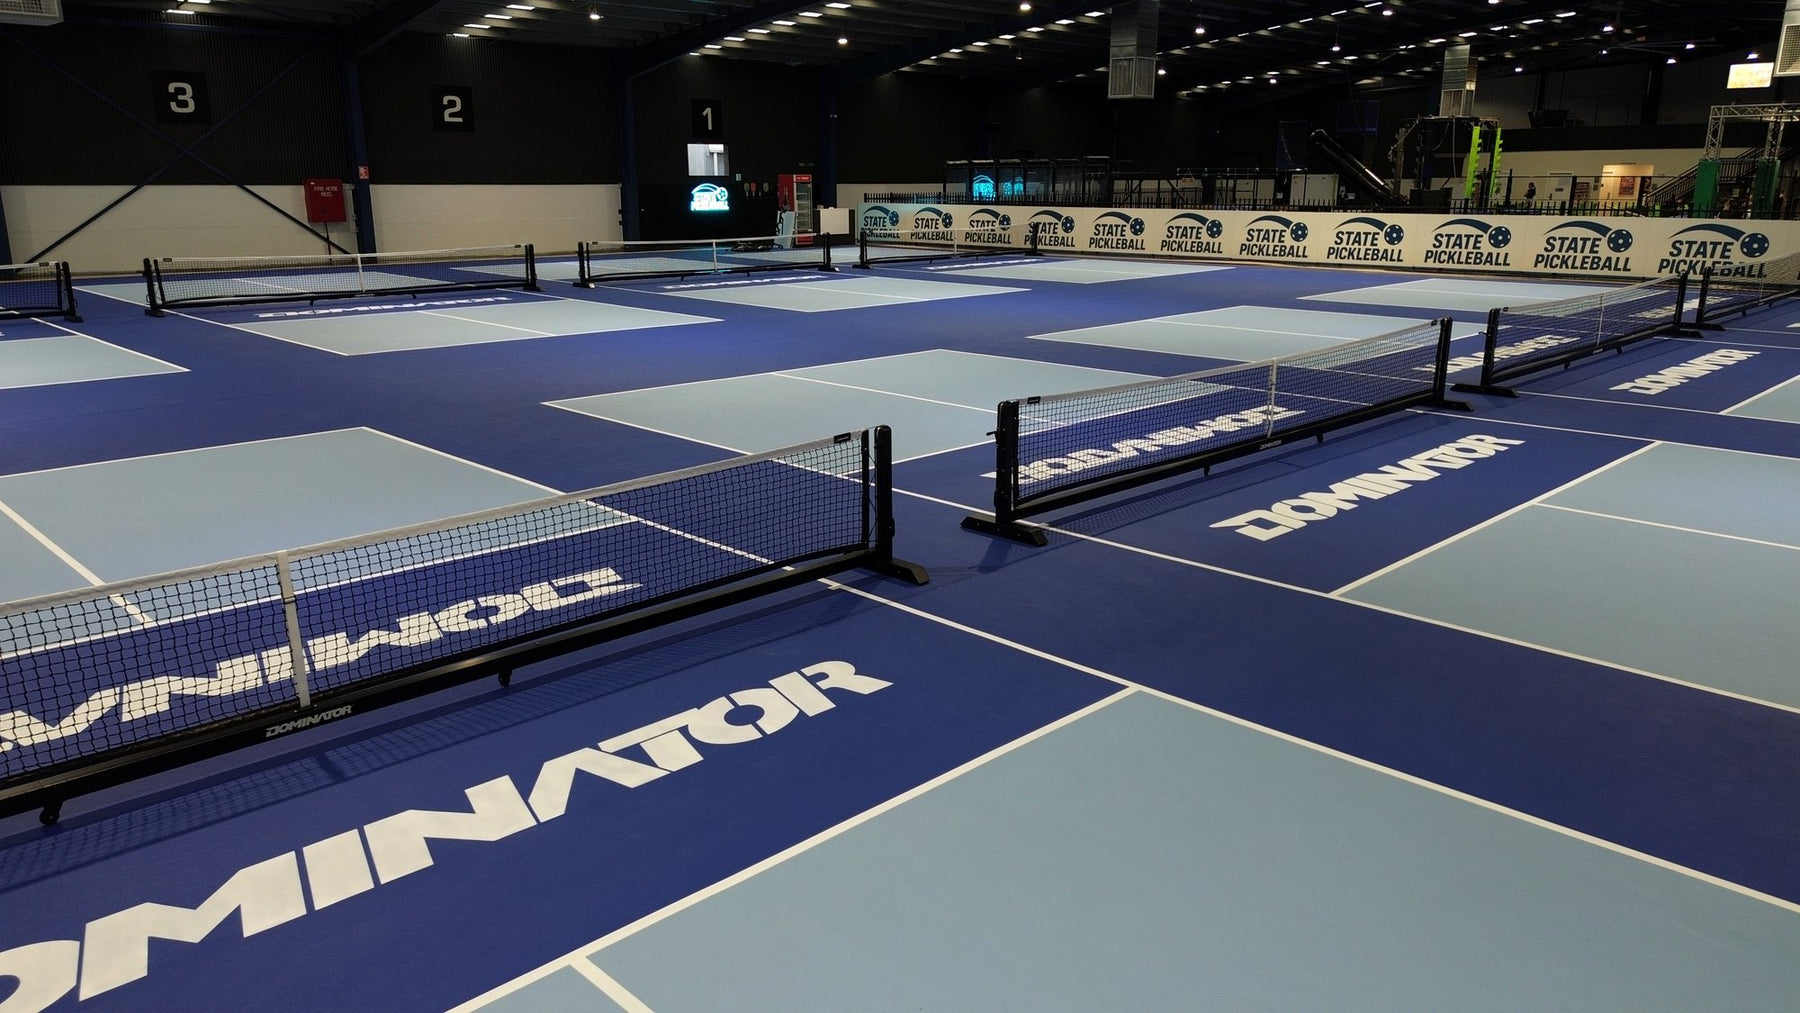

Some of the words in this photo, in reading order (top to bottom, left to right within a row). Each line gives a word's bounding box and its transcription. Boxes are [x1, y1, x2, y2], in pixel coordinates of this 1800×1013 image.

[168, 82, 195, 113] 3
[442, 95, 463, 122] 2
[702, 107, 712, 130] 1
[864, 216, 887, 227] STATE
[914, 217, 939, 229] STATE
[969, 219, 997, 232] STATE
[910, 231, 954, 241] PICKLEBALL
[1094, 223, 1127, 237] STATE
[1166, 225, 1203, 240] STATE
[1246, 228, 1286, 243] STATE
[964, 232, 1012, 244] PICKLEBALL
[1089, 237, 1145, 250] PICKLEBALL
[1334, 231, 1380, 246] STATE
[1432, 233, 1483, 250] STATE
[1543, 236, 1602, 254] STATE
[1160, 239, 1223, 254] PICKLEBALL
[1239, 244, 1308, 258] PICKLEBALL
[1669, 240, 1734, 259] STATE
[1326, 247, 1403, 262] PICKLEBALL
[1424, 250, 1510, 266] PICKLEBALL
[1534, 253, 1632, 271] PICKLEBALL
[1208, 434, 1527, 541] DOMINATOR
[265, 705, 352, 737] DOMINATOR
